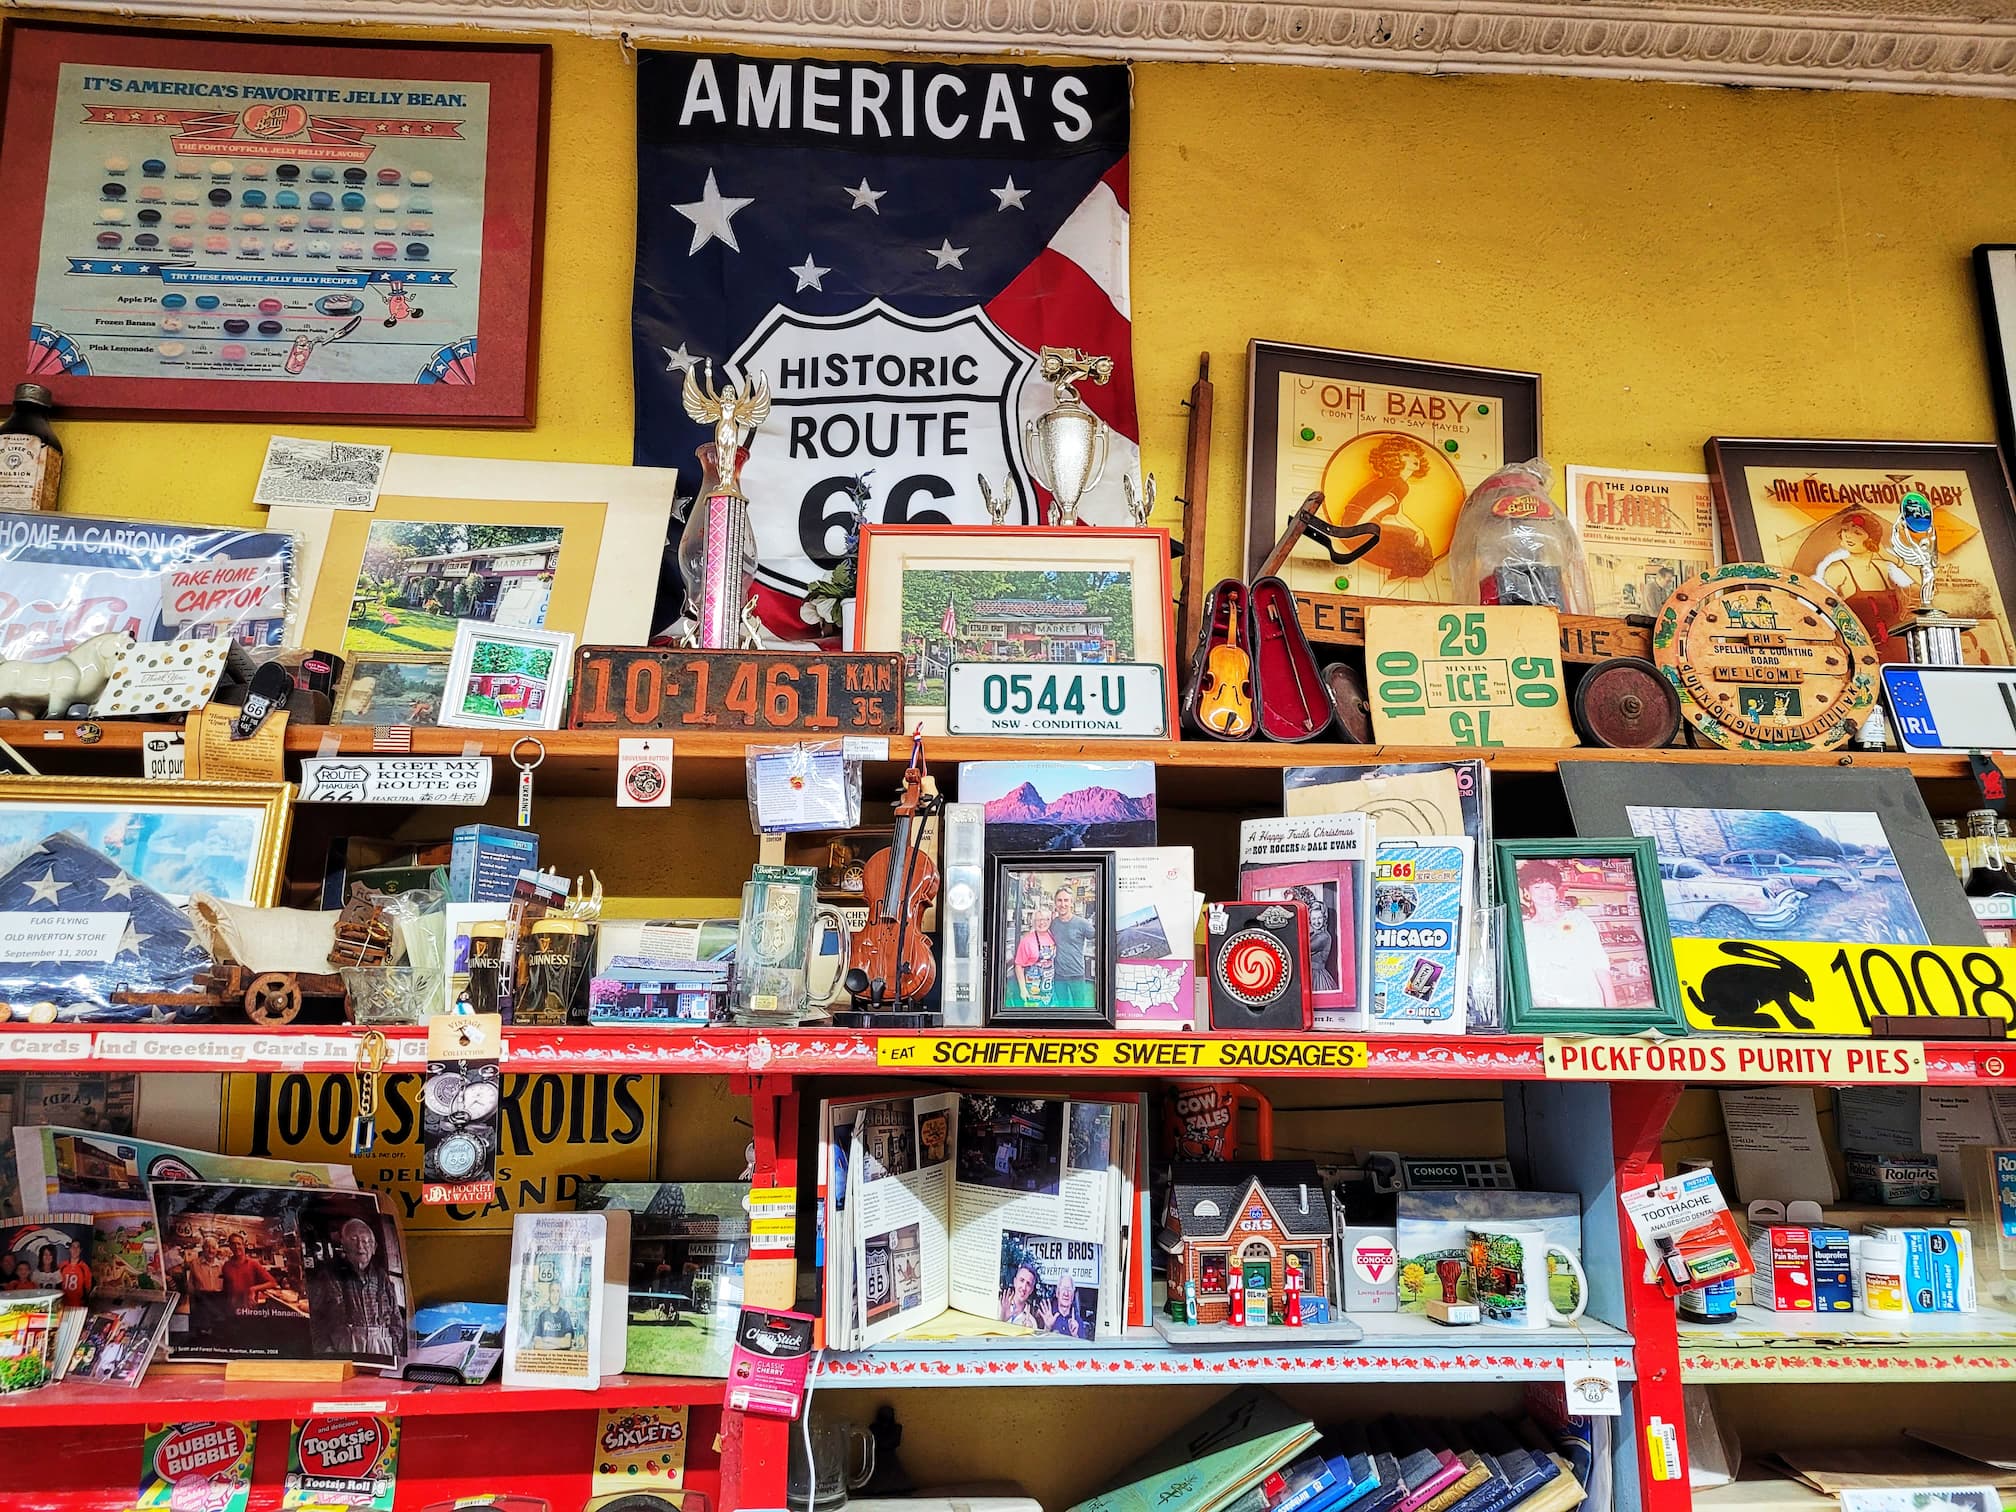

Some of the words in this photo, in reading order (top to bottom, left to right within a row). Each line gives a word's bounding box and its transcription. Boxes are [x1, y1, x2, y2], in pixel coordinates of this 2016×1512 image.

[83, 77, 122, 91] IT'S
[125, 80, 239, 98] AMERICA'S
[242, 86, 340, 103] FAVORITE
[343, 90, 404, 105] JELLY
[679, 58, 1093, 143] AMERICA'S
[264, 105, 289, 119] Jelly
[255, 117, 282, 133] Belly
[179, 143, 196, 151] THE
[198, 143, 228, 152] FORTY
[229, 145, 269, 154] OFFICIAL
[271, 147, 296, 155] JELLY
[298, 148, 325, 156] BELLY
[326, 150, 365, 158] FLAVORS
[171, 273, 189, 281] TRY
[190, 274, 219, 282] THESE
[293, 276, 319, 284] BELLY
[320, 277, 358, 285] RECIPES
[118, 296, 144, 304] Apple
[146, 296, 157, 304] Pie
[95, 319, 123, 327] Frozen
[126, 319, 156, 327] Banana
[89, 344, 109, 352] Pink
[111, 345, 154, 353] Lemonade
[780, 353, 979, 391] HISTORIC
[1320, 384, 1365, 412] OH
[1387, 392, 1471, 423] BABY
[1360, 413, 1378, 423] SAY
[1383, 416, 1396, 425] NO
[1407, 419, 1426, 429] SAY
[789, 411, 970, 459] ROUTE
[1605, 482, 1625, 491] THE
[1630, 484, 1669, 494] JOPLIN
[1773, 478, 1798, 501] MY
[1915, 482, 1963, 506] BABY
[1585, 480, 1671, 529] GLOBE
[798, 474, 956, 571] 66
[0, 520, 59, 550] HOME
[61, 526, 77, 551] A
[82, 527, 166, 557] CARTON
[173, 534, 199, 559] OF
[172, 569, 209, 587] TAKE
[212, 567, 258, 584] HOME
[175, 586, 270, 614] CARTON
[1037, 625, 1076, 634] MARKET
[1439, 613, 1487, 656] 25
[1713, 645, 1754, 655] SPELLING
[1770, 647, 1813, 657] COUNTING
[1751, 656, 1779, 665] BOARD
[846, 663, 891, 692] KAN
[1376, 651, 1426, 719] 100
[1511, 657, 1559, 708] 50
[1447, 674, 1491, 702] ICE
[247, 703, 263, 716] 66
[852, 697, 882, 727] 35
[992, 720, 1020, 729] NSW
[1032, 720, 1122, 729] CONDITIONAL
[1450, 711, 1504, 747] 75
[1900, 716, 1936, 735] IRL
[152, 755, 166, 778] got
[377, 762, 383, 770] I
[391, 762, 438, 770] GET
[446, 762, 481, 770] MY
[321, 770, 361, 780] ROUTE
[376, 781, 449, 790] ROUTE
[456, 782, 478, 790] 66
[1313, 827, 1355, 838] Christmas
[1253, 845, 1268, 855] ROY
[1270, 844, 1300, 853] ROGERS
[1307, 842, 1328, 852] DALE
[1330, 840, 1357, 850] EVANS
[1392, 863, 1412, 877] 66
[1974, 902, 2010, 914] OOD
[30, 917, 54, 925] FLAG
[56, 917, 89, 925] FLYING
[4, 933, 24, 941] OLD
[26, 933, 74, 941] RIVERTON
[75, 933, 107, 941] STORE
[4, 949, 56, 958] September
[58, 950, 72, 958] 11,
[74, 949, 98, 958] 2001
[529, 953, 570, 967] GUINNESS
[1831, 947, 2016, 1032] 1008
[1417, 1008, 1441, 1018] MICA
[10, 1038, 80, 1054] Cards
[143, 1041, 245, 1060] Greeting
[253, 1040, 319, 1056] Cards
[324, 1043, 347, 1056] In
[891, 1047, 915, 1059] EAT
[933, 1041, 1099, 1064] SCHIFFNER'S
[1113, 1043, 1206, 1065] SWEET
[1219, 1043, 1355, 1067] SAUSAGES
[1561, 1044, 1727, 1074] PICKFORDS
[1738, 1047, 1833, 1074] PURITY
[1848, 1048, 1911, 1075] PIES
[1177, 1092, 1216, 1115] COW
[1187, 1108, 1230, 1129] TALES
[1413, 1167, 1458, 1176] CONOCO
[1886, 1168, 1937, 1182] Rolaids
[453, 1184, 493, 1193] POCKET
[453, 1192, 493, 1201] WATCH
[1641, 1194, 1712, 1222] TOOTHACHE
[1240, 1219, 1273, 1231] GAS
[1650, 1215, 1691, 1232] ANALGÉSICO
[1691, 1208, 1714, 1220] DENTAL
[1068, 1242, 1094, 1260] BROS
[1911, 1235, 1919, 1253] Pain
[866, 1254, 885, 1266] ILLINOIS
[1774, 1252, 1786, 1260] Pain
[1786, 1252, 1809, 1261] Reliever
[1815, 1251, 1848, 1260] Ibuprofen
[541, 1270, 552, 1278] 66
[1072, 1268, 1093, 1278] STORE
[1911, 1254, 1920, 1279] Relief
[64, 1273, 78, 1291] 18
[868, 1276, 884, 1296] 66
[756, 1361, 785, 1371] CLASSIC
[756, 1367, 784, 1376] CHERRY
[1588, 1392, 1599, 1400] 66
[164, 1427, 237, 1460] DUBBLE
[303, 1428, 376, 1455] Tootsie
[167, 1442, 239, 1477] BUBBLE
[322, 1446, 364, 1467] Roll
[305, 1478, 345, 1490] Tootsie
[346, 1480, 370, 1492] Roll
